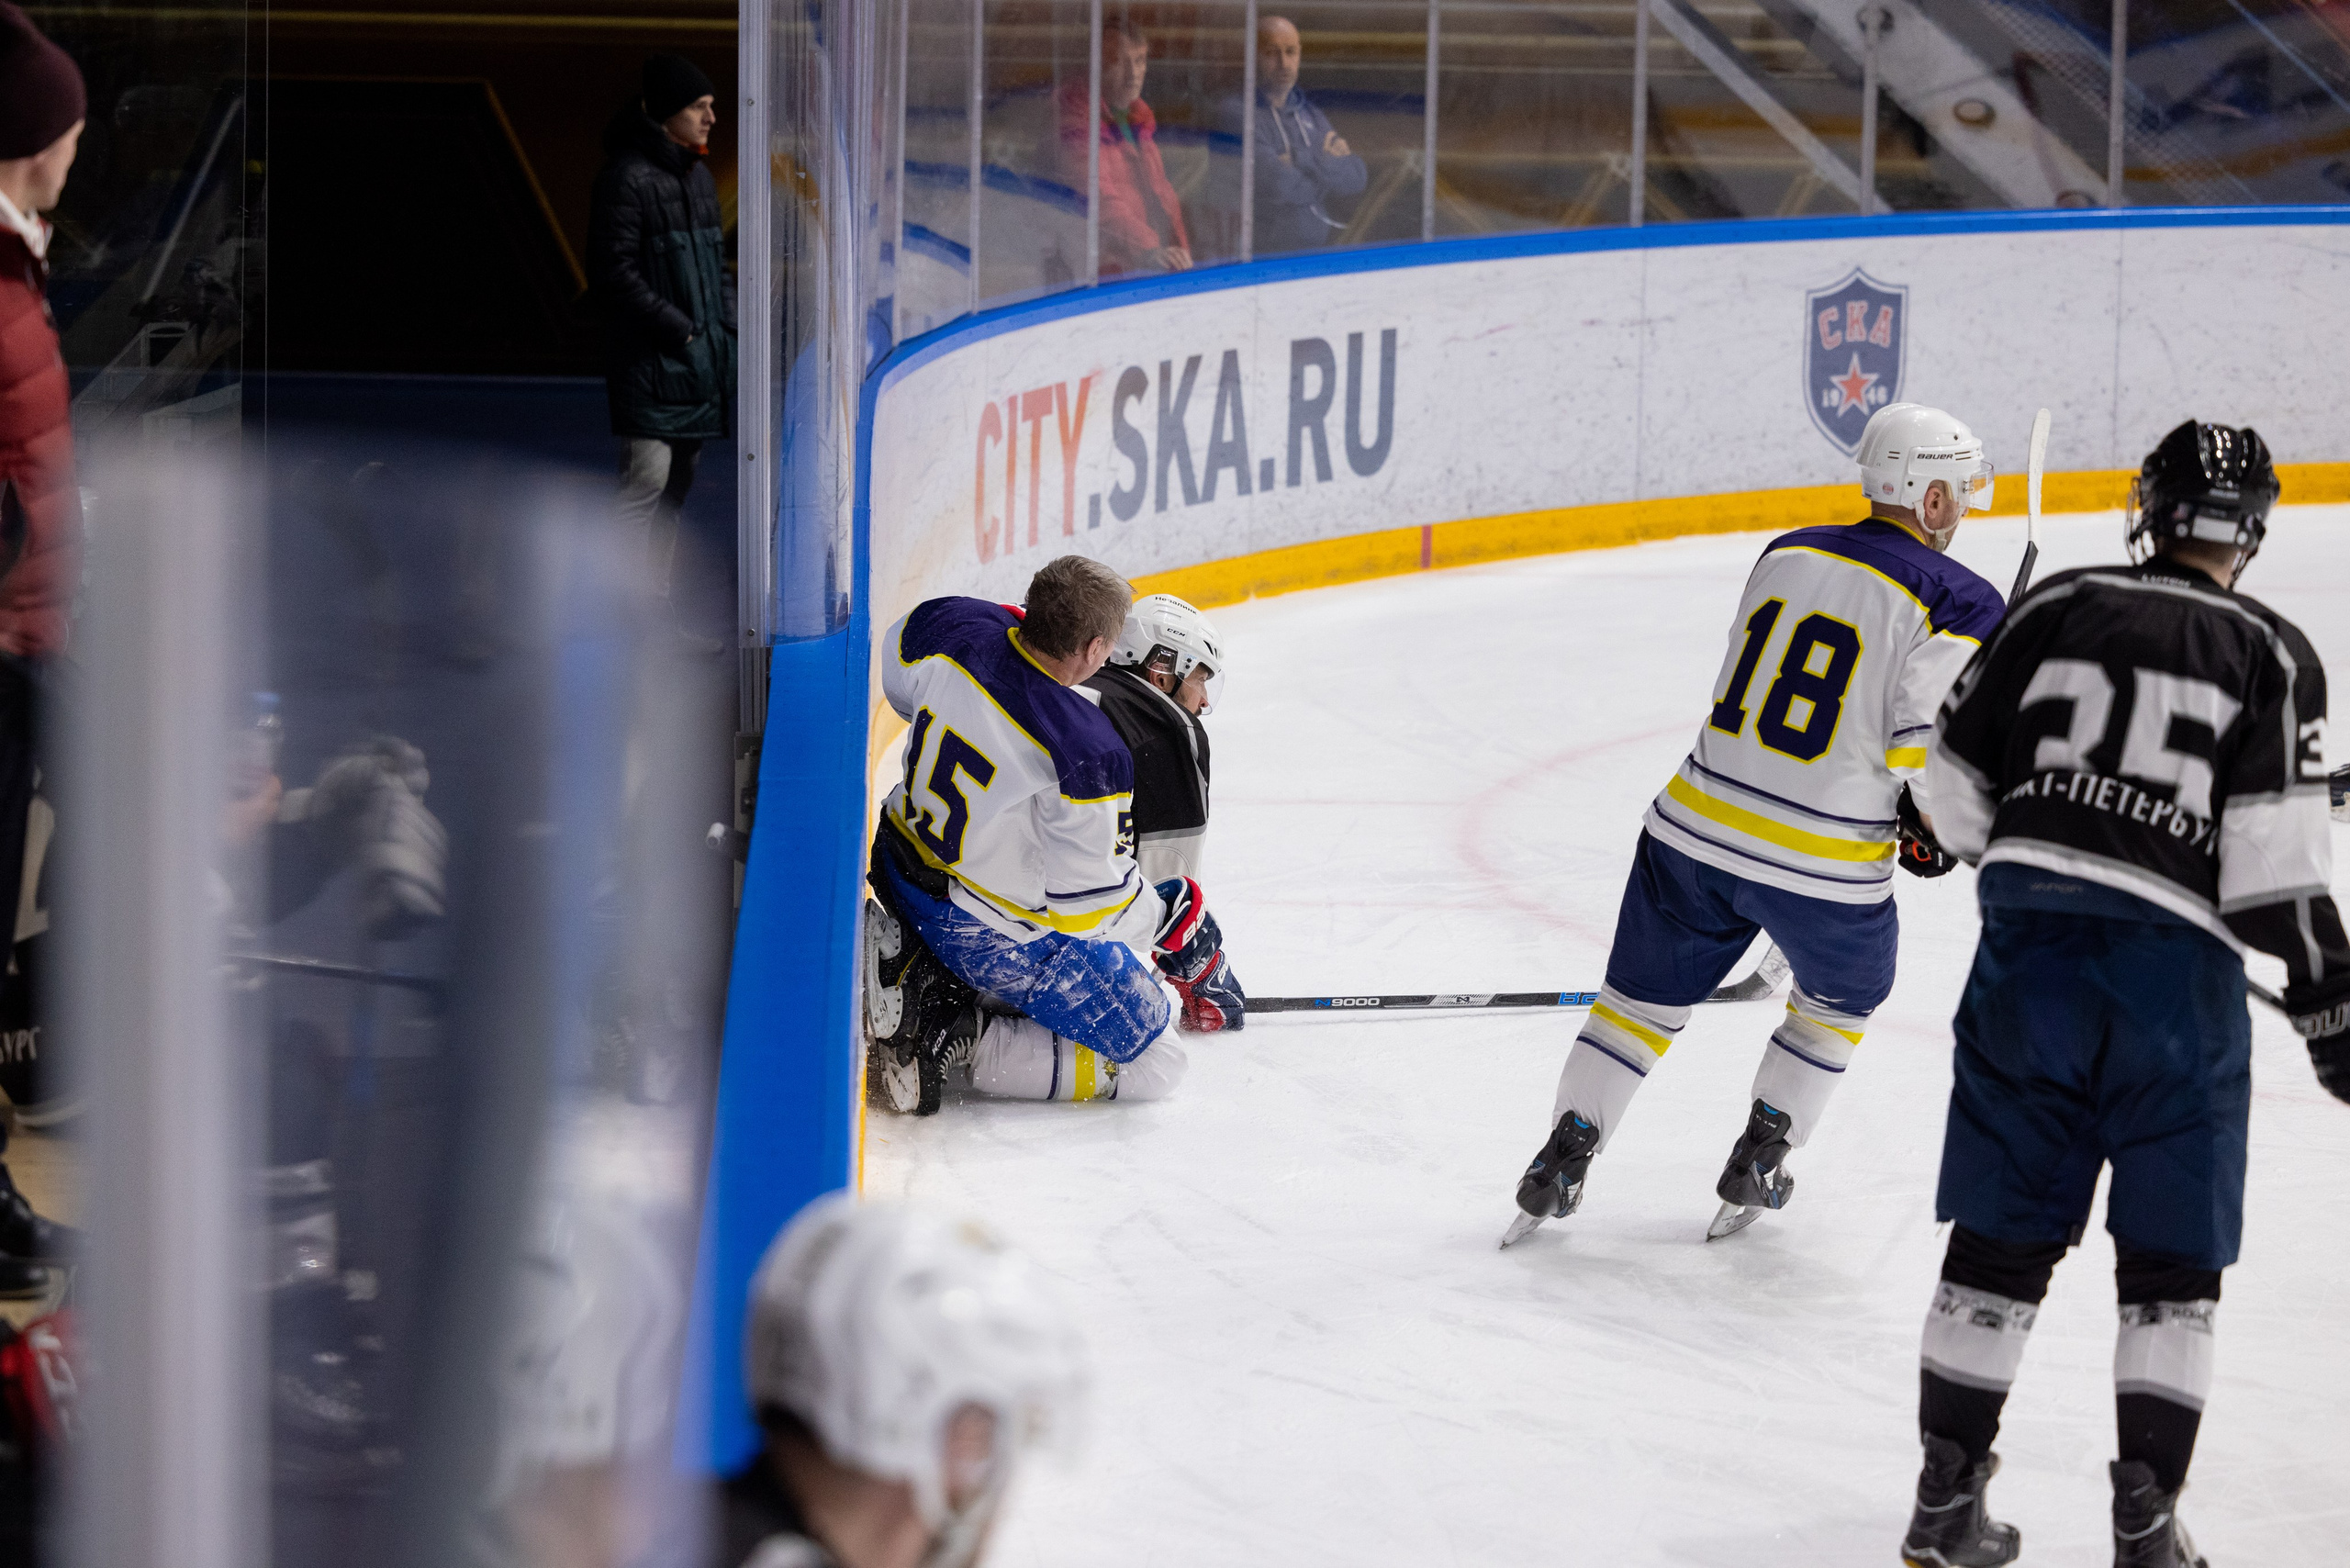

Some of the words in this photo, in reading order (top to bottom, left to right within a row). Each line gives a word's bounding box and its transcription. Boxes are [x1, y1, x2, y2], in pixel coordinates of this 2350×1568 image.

[974, 328, 1398, 565] CITY.SKA.RU
[1167, 628, 1186, 637] CCM
[1709, 596, 1864, 764] 18
[903, 705, 997, 866] 15
[931, 1028, 947, 1057] CCM
